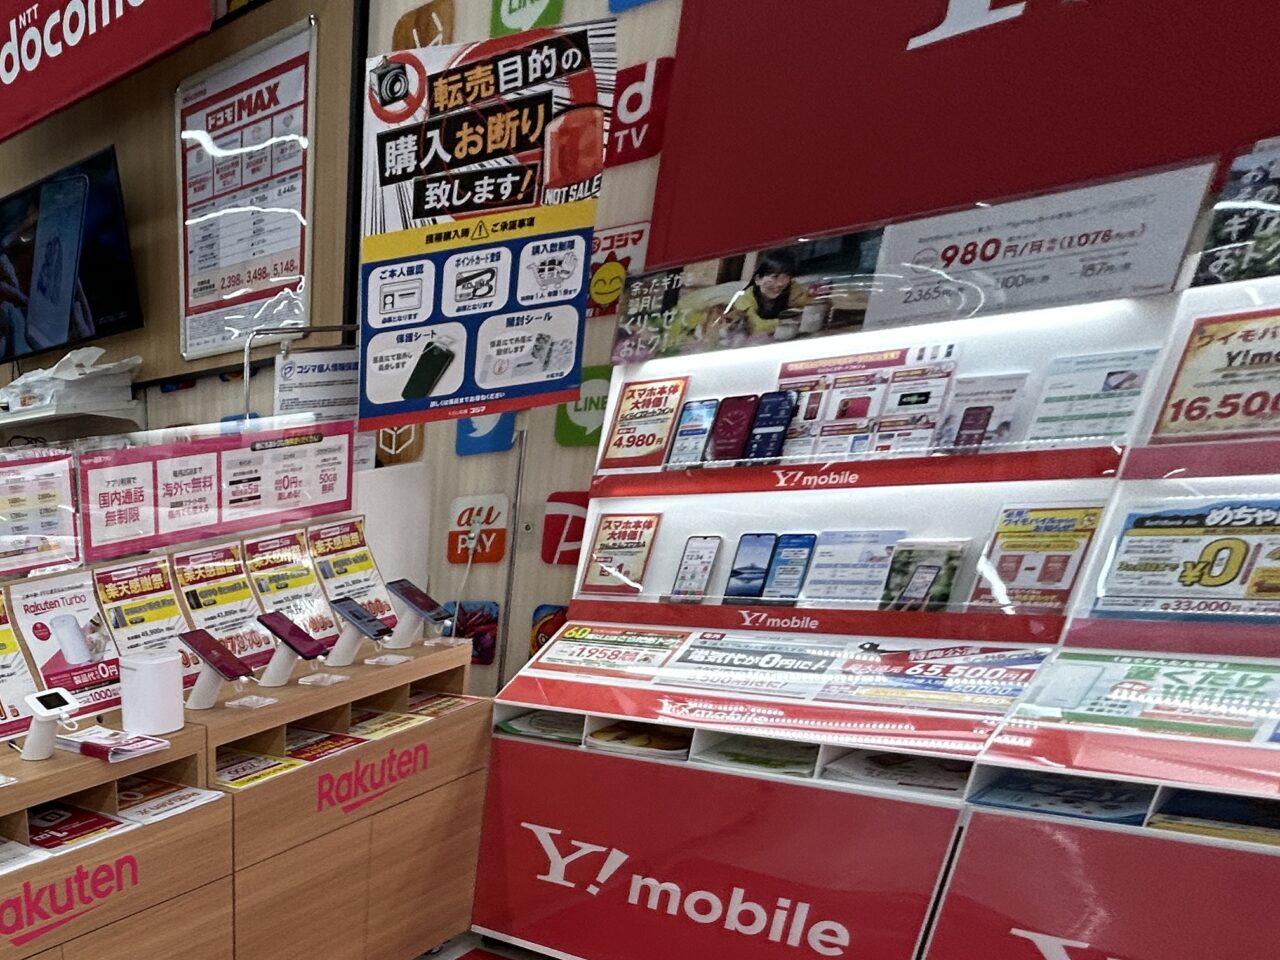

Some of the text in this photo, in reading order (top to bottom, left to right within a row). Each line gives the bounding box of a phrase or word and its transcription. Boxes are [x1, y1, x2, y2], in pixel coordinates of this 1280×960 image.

[19, 4, 40, 30] NTT
[433, 46, 582, 111] 転売目的の
[237, 81, 280, 121] MAX
[385, 104, 545, 177] 購入お断り
[614, 123, 647, 153] TV
[544, 177, 600, 204] NOT SALE
[600, 229, 645, 251] コジマ
[626, 383, 681, 401] スマホ本体
[162, 474, 214, 498] 海外で無料
[773, 470, 860, 487] Y!mobile
[98, 486, 145, 509] 国内通話
[105, 506, 140, 527] 無制限
[458, 504, 502, 527] au
[601, 519, 654, 531] スマホ本体
[104, 573, 164, 600] 楽天感謝祭
[22, 593, 87, 616] Rakuten Turbo
[738, 610, 819, 630] Y!mobile
[317, 742, 429, 815] Rakuten
[520, 821, 851, 957] Y!mobile
